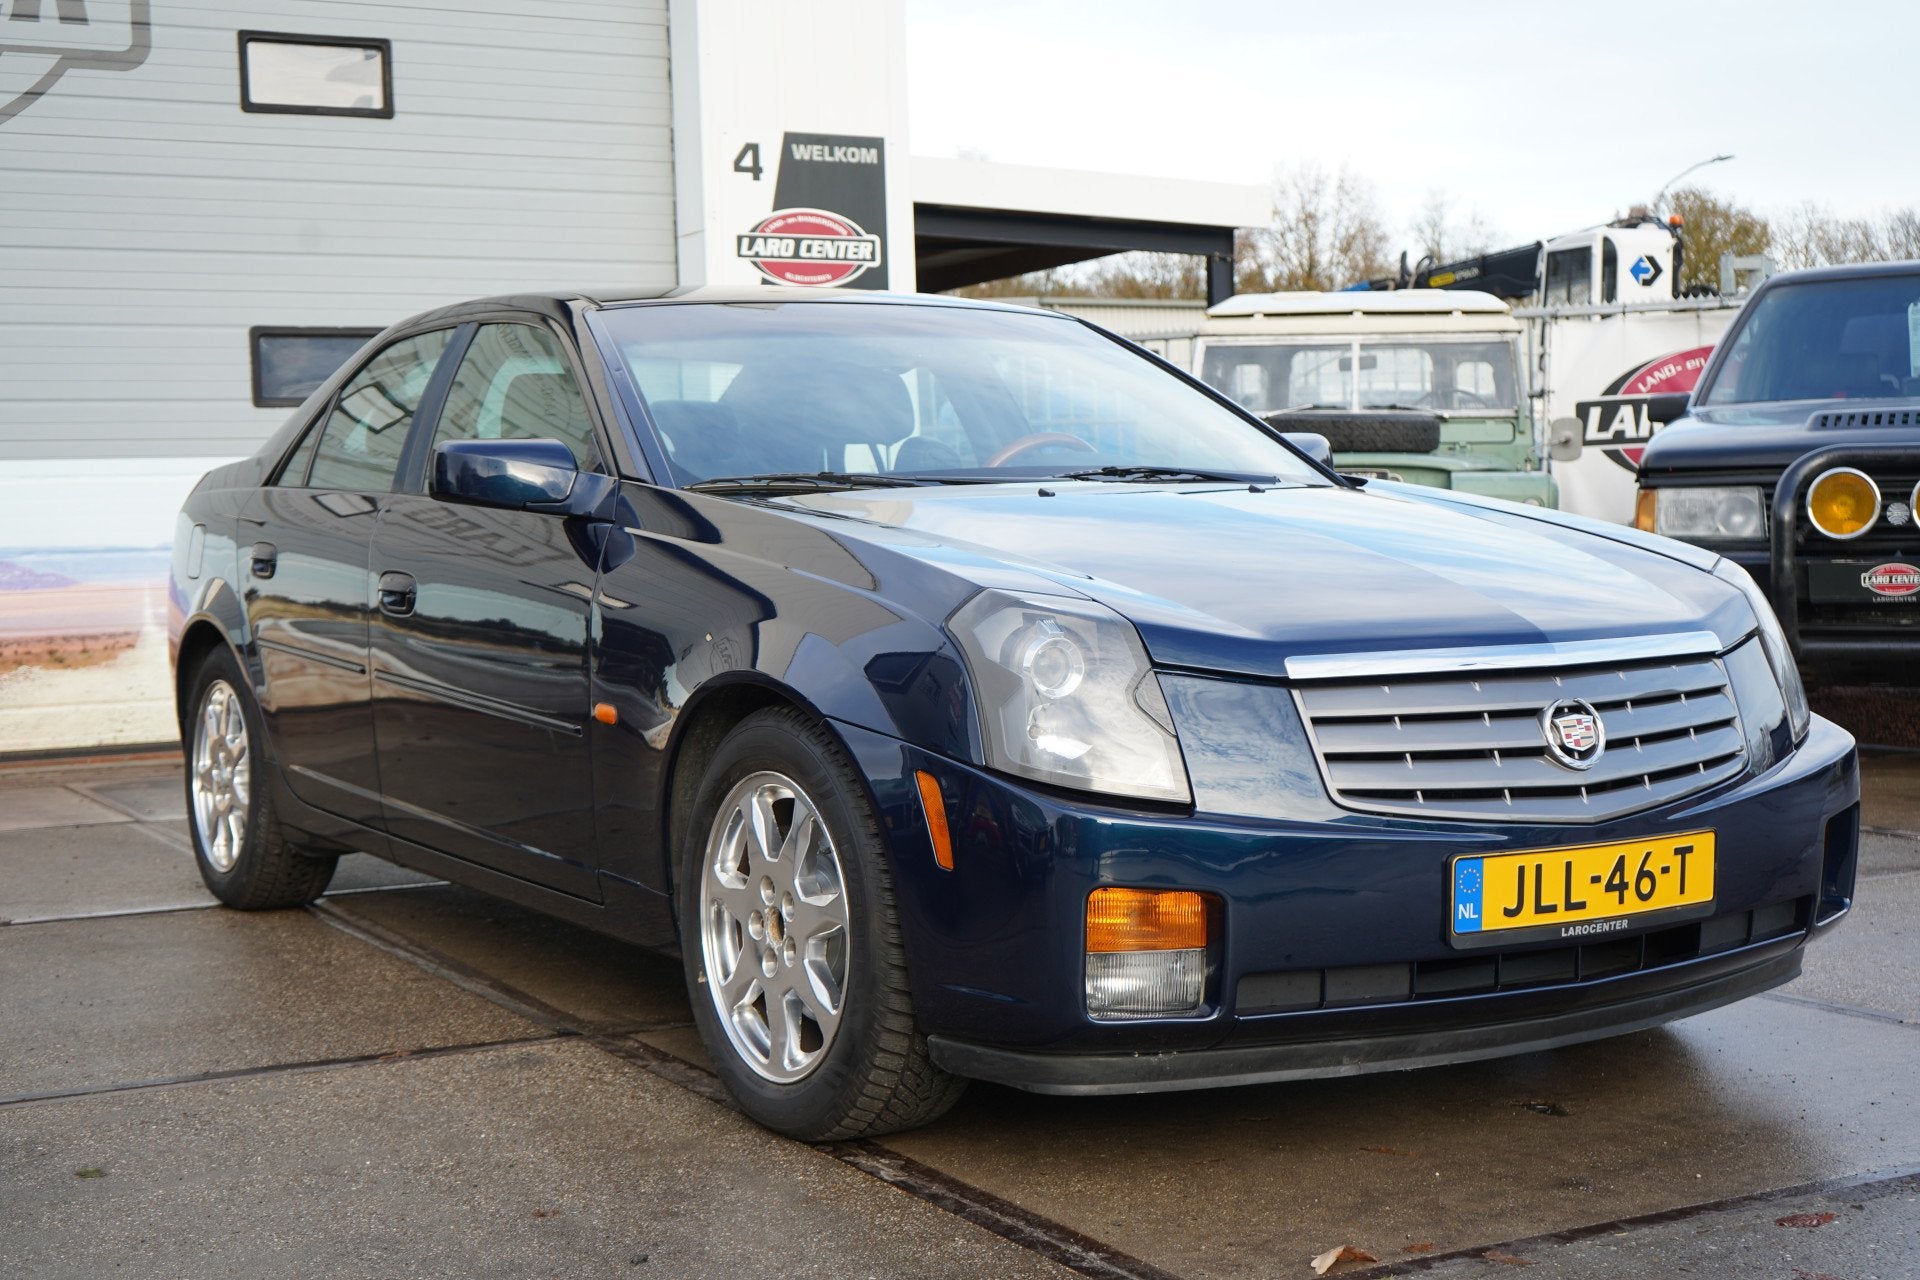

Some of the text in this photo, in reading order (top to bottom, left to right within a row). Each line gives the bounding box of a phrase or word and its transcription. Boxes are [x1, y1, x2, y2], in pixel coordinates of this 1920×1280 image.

[733, 142, 764, 181] 4
[791, 143, 878, 164] WELKOM
[739, 237, 873, 260] LARO CENTER
[1637, 357, 1706, 393] LAND- en
[1865, 575, 1920, 585] LARO CENTE
[1503, 845, 1694, 918] JLL-46-T
[1458, 903, 1478, 920] NL
[1561, 919, 1629, 937] LAROCENTER
